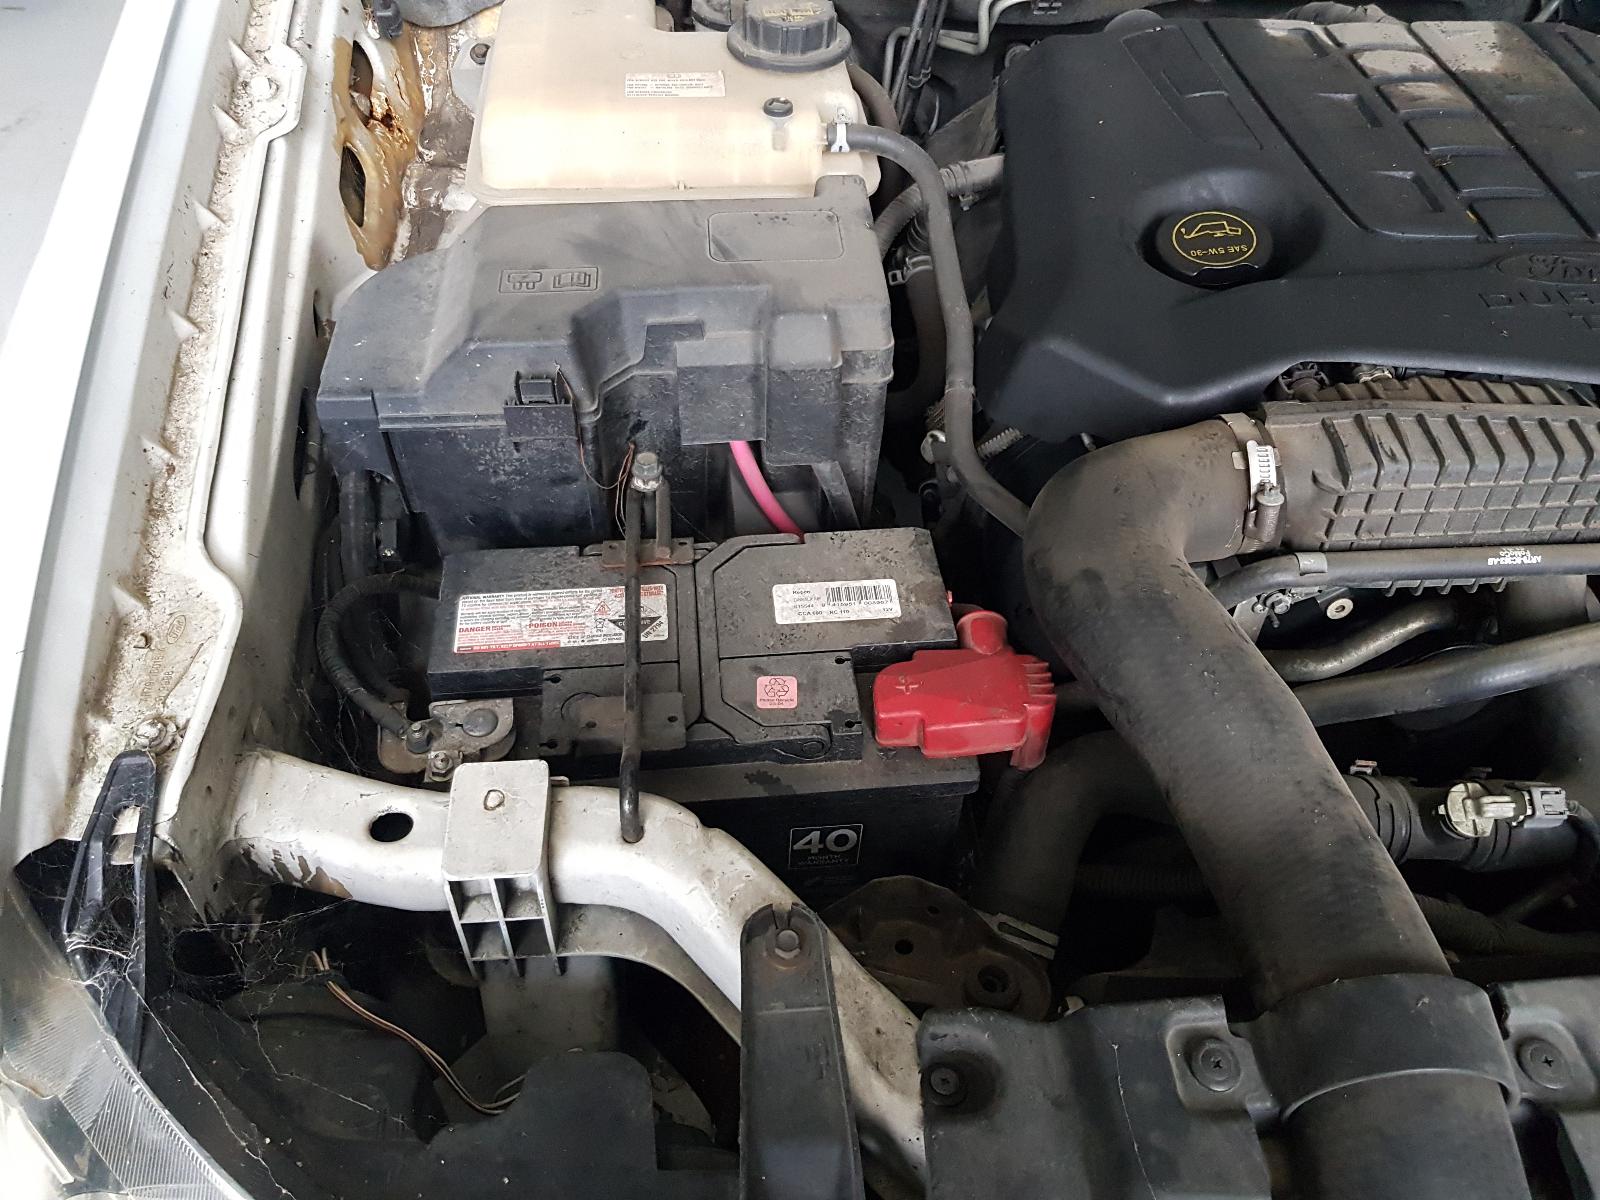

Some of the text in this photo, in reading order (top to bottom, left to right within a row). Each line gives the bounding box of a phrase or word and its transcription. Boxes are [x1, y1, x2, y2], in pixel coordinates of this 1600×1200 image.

[1190, 245, 1248, 257] SAE 5W-30
[458, 625, 491, 633] DANGER
[528, 621, 558, 629] POISON
[793, 829, 858, 853] 40
